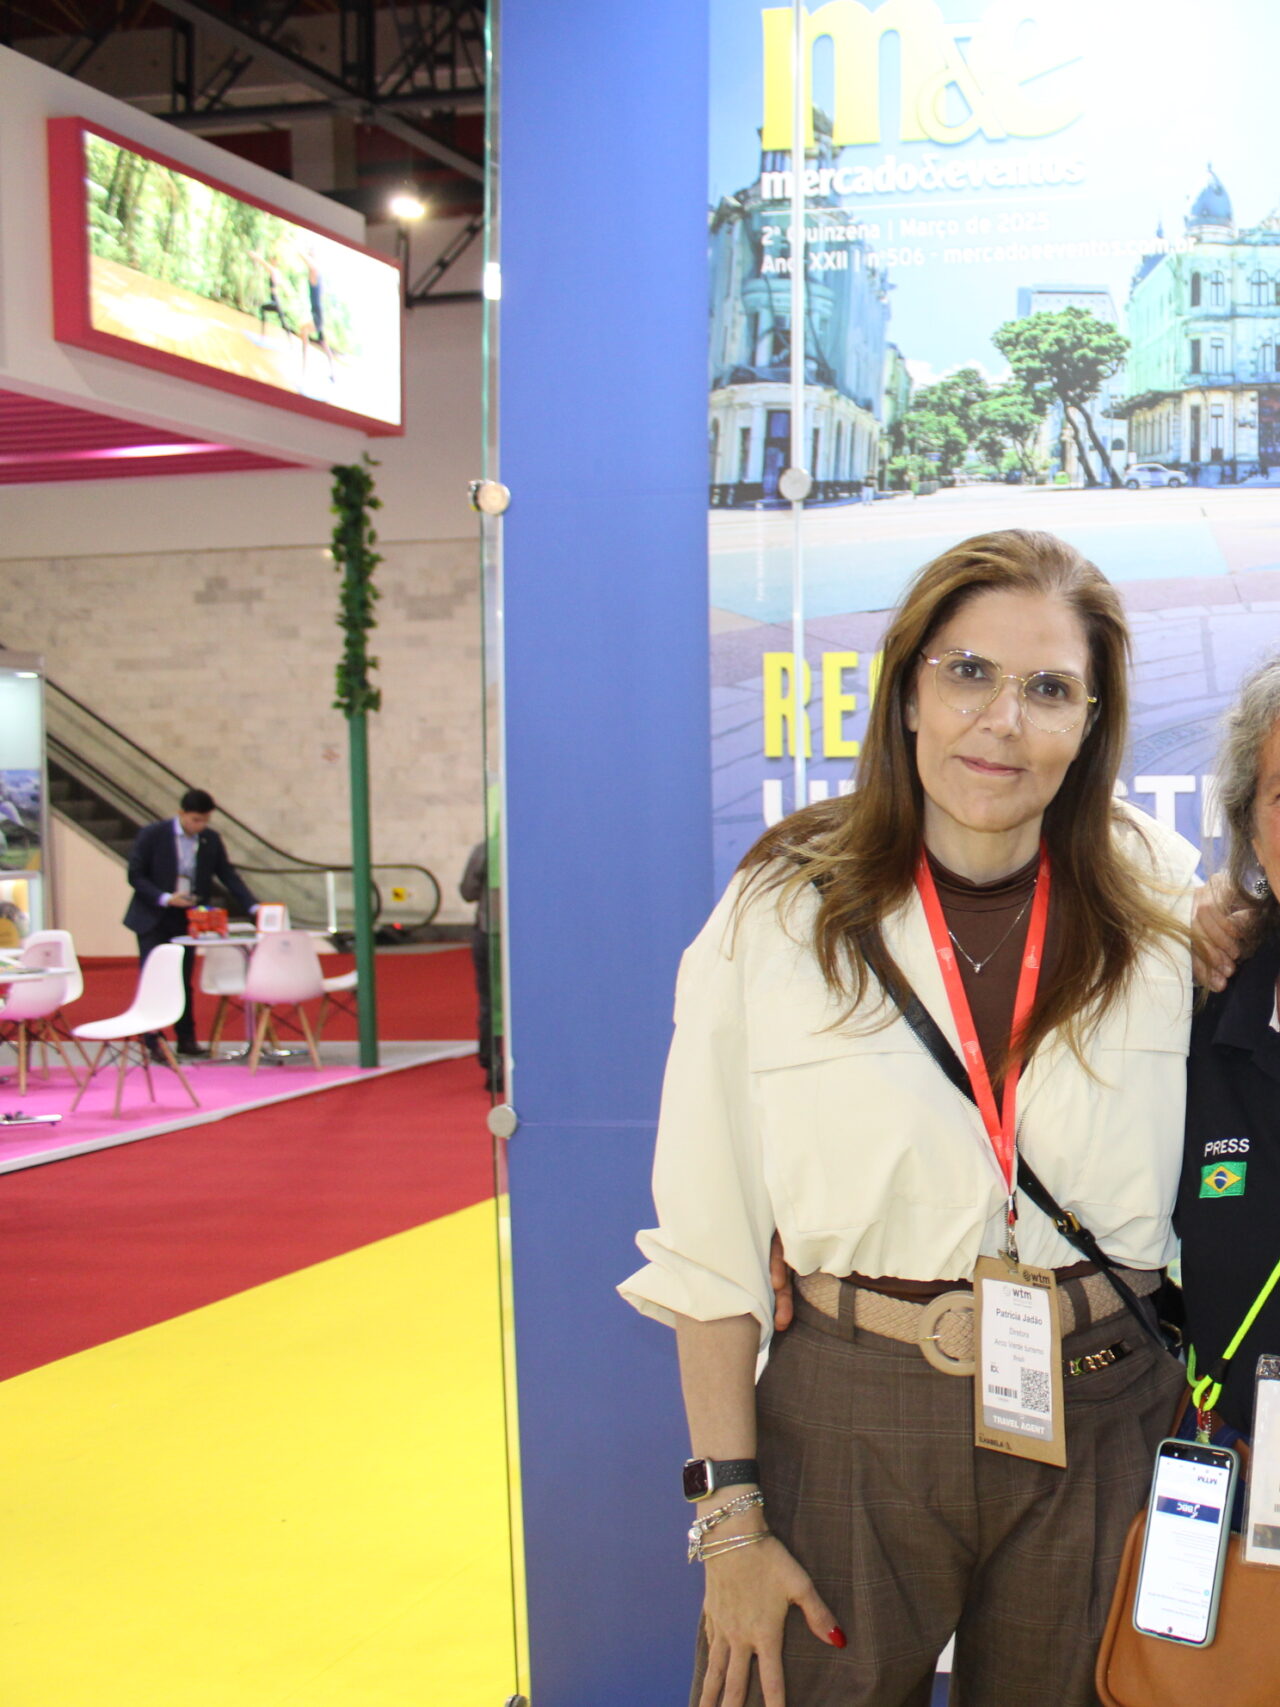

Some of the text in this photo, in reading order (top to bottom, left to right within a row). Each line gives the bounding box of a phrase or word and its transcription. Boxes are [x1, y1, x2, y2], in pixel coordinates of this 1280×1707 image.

[761, 152, 1087, 200] mercado&eventos
[901, 218, 961, 239] Março
[965, 216, 992, 234] de
[996, 211, 1052, 232] 2025
[809, 251, 848, 271] XXII
[1203, 1138, 1250, 1158] PRESS
[1031, 1272, 1051, 1285] wtm
[1012, 1287, 1032, 1300] wtm
[992, 1414, 1046, 1435] TRAVEL AGENT
